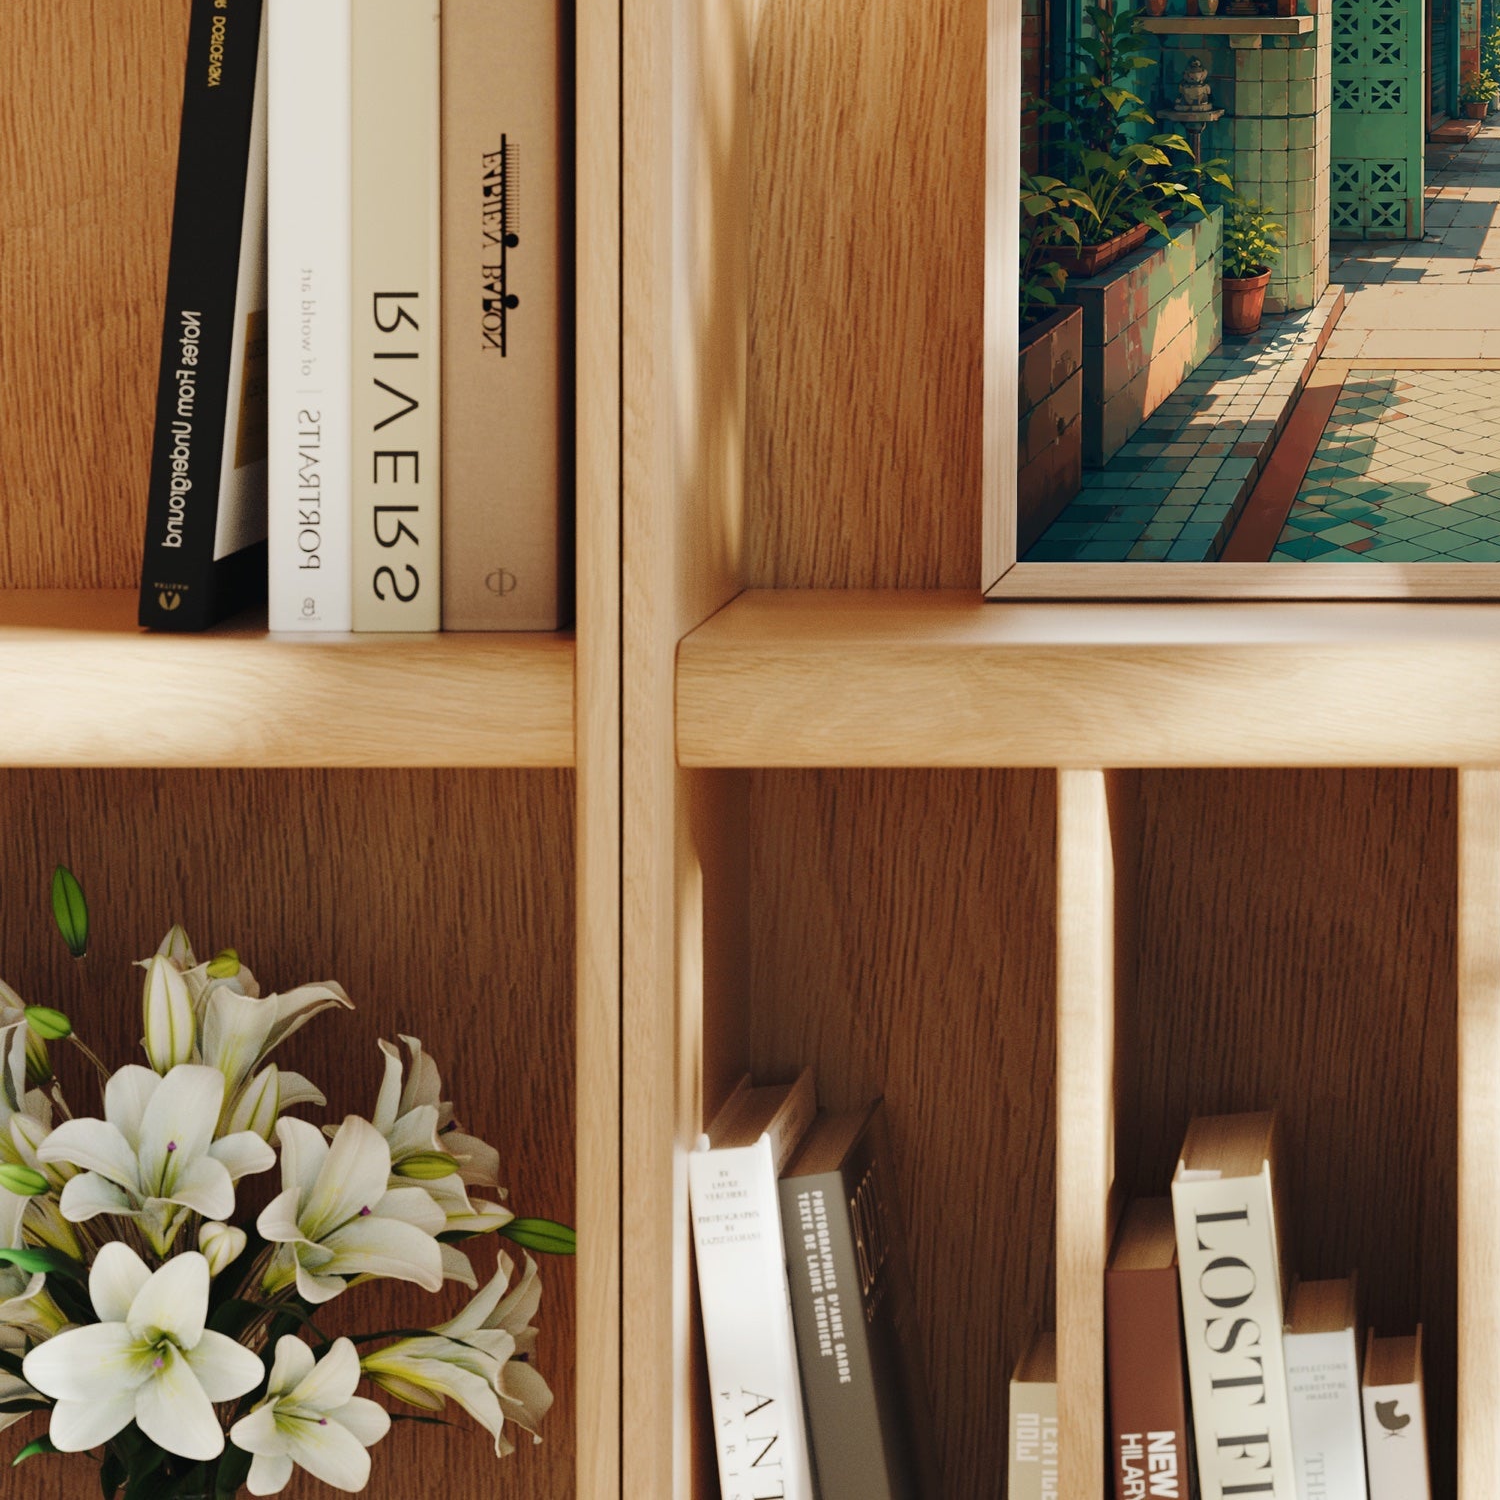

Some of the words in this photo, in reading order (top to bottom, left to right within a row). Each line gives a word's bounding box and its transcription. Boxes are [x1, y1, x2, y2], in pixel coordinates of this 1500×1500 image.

[798, 1191, 814, 1231] TEXTE
[803, 1233, 817, 1251] DE
[811, 1190, 837, 1290] PHOTOGRAPHIES
[806, 1254, 823, 1294] LAURE
[1194, 1203, 1266, 1407] LOST
[1147, 1431, 1179, 1498] NEW
